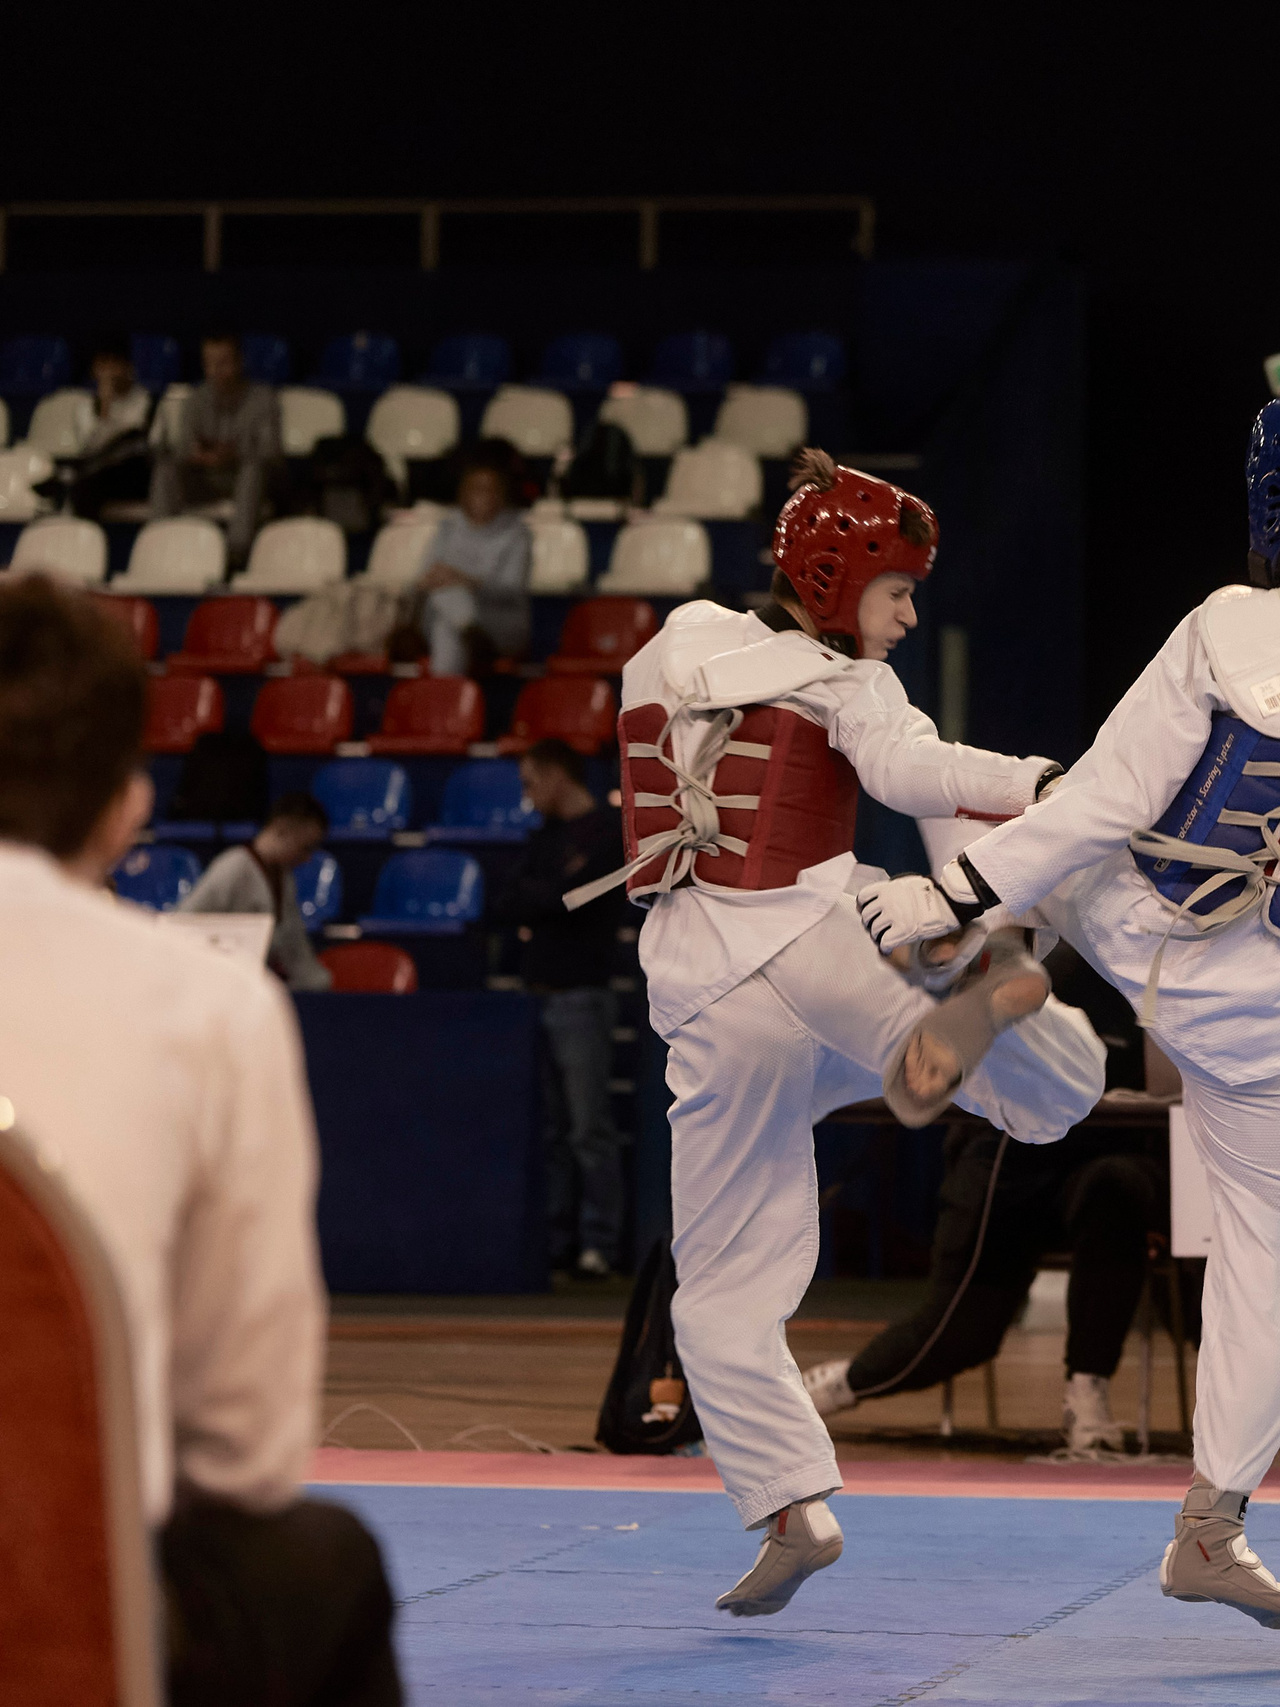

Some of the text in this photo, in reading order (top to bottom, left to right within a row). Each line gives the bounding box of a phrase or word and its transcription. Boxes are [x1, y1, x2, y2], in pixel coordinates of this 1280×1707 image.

[1178, 805, 1199, 839] rotector
[1200, 765, 1221, 797] Scoring
[1216, 733, 1234, 765] System
